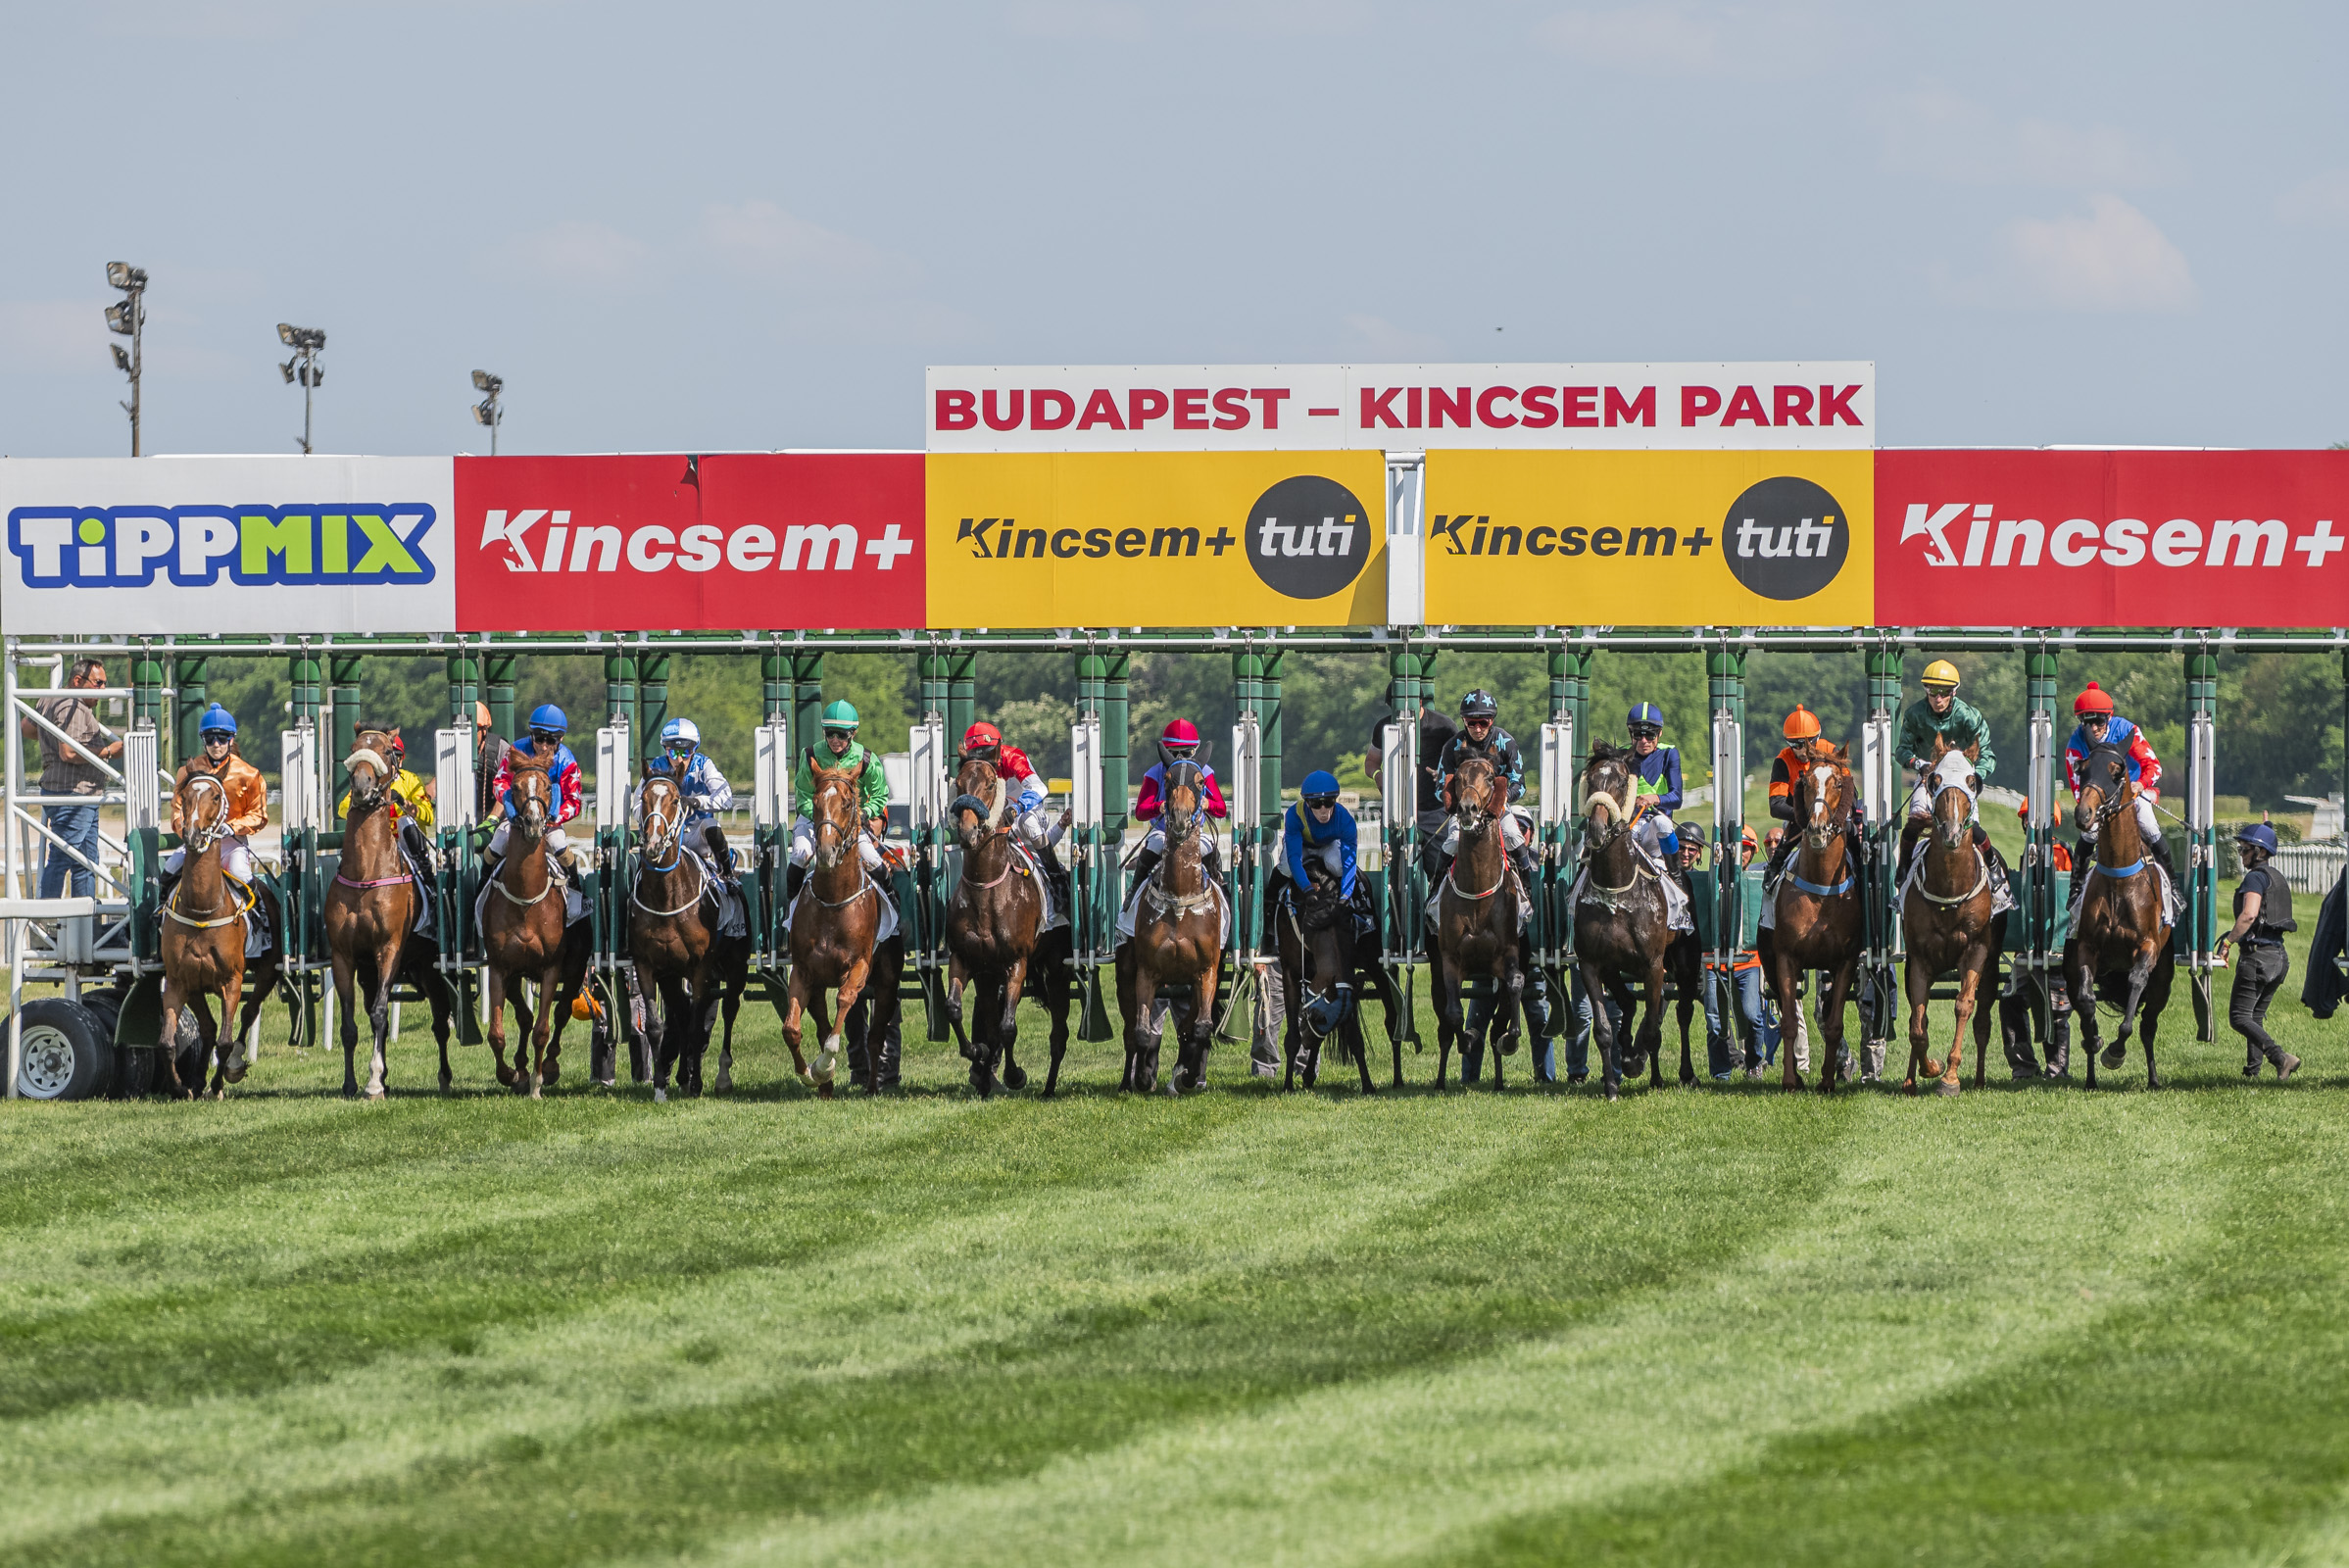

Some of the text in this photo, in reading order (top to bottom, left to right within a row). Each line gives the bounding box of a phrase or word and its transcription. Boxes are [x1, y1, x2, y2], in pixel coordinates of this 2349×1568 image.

[935, 388, 1291, 431] BUDAPEST
[1360, 386, 1656, 429] KINCSEM
[1681, 384, 1863, 428] PARK
[479, 509, 913, 572] Kincsem+
[955, 517, 1236, 559] Kincsem+
[1258, 514, 1357, 558] tuti
[1430, 514, 1713, 557] Kincsem+
[1736, 514, 1835, 559] tuti
[1899, 503, 2345, 567] Kincsem+
